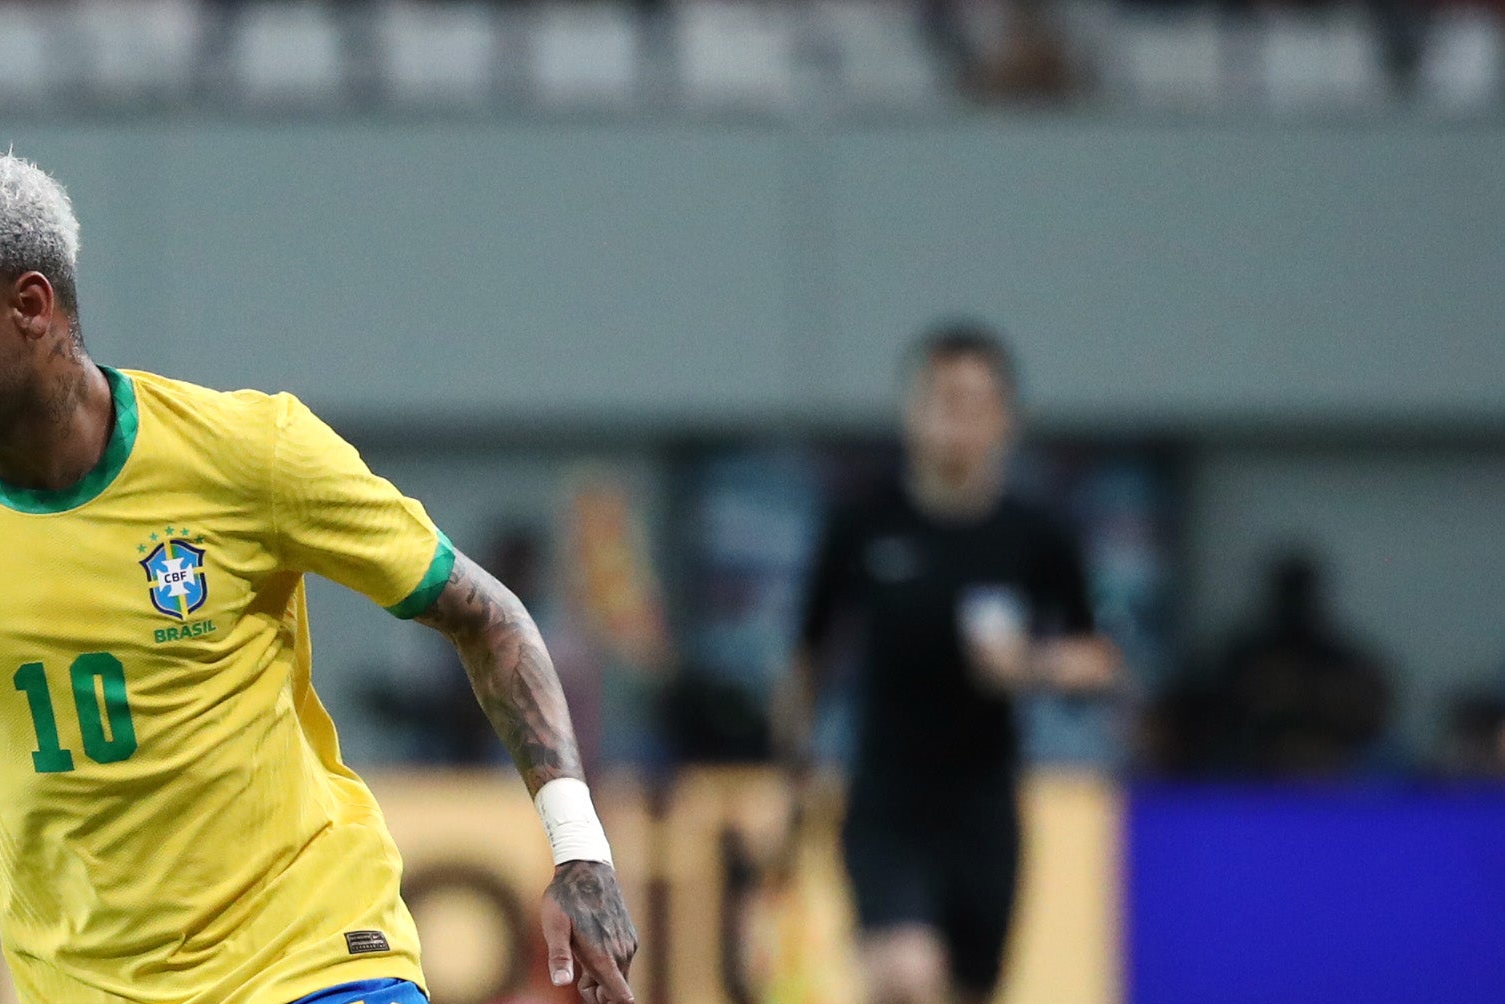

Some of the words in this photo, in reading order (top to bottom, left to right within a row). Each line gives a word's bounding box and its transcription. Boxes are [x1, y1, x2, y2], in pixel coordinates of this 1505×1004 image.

[164, 571, 187, 584] CBF
[153, 619, 217, 643] BRASIL
[12, 651, 138, 773] 10
